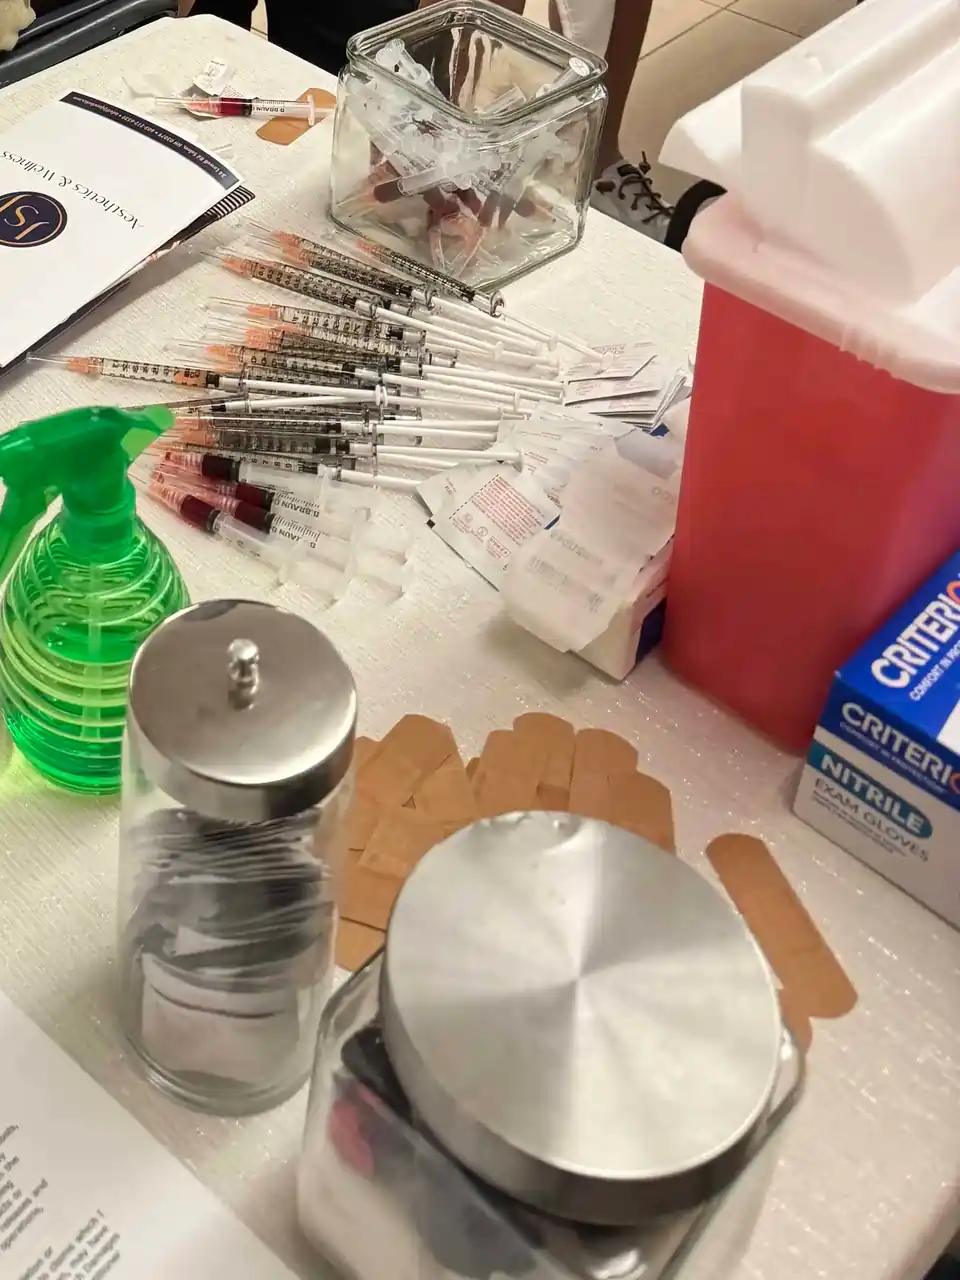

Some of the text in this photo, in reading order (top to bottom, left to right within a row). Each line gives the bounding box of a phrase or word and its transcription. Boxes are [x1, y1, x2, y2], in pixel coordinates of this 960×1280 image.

[0, 149, 145, 230] Aesthetics & Wellness
[812, 776, 861, 814] EXAM
[861, 809, 931, 862] GLOVES
[817, 751, 926, 835] NITRILE
